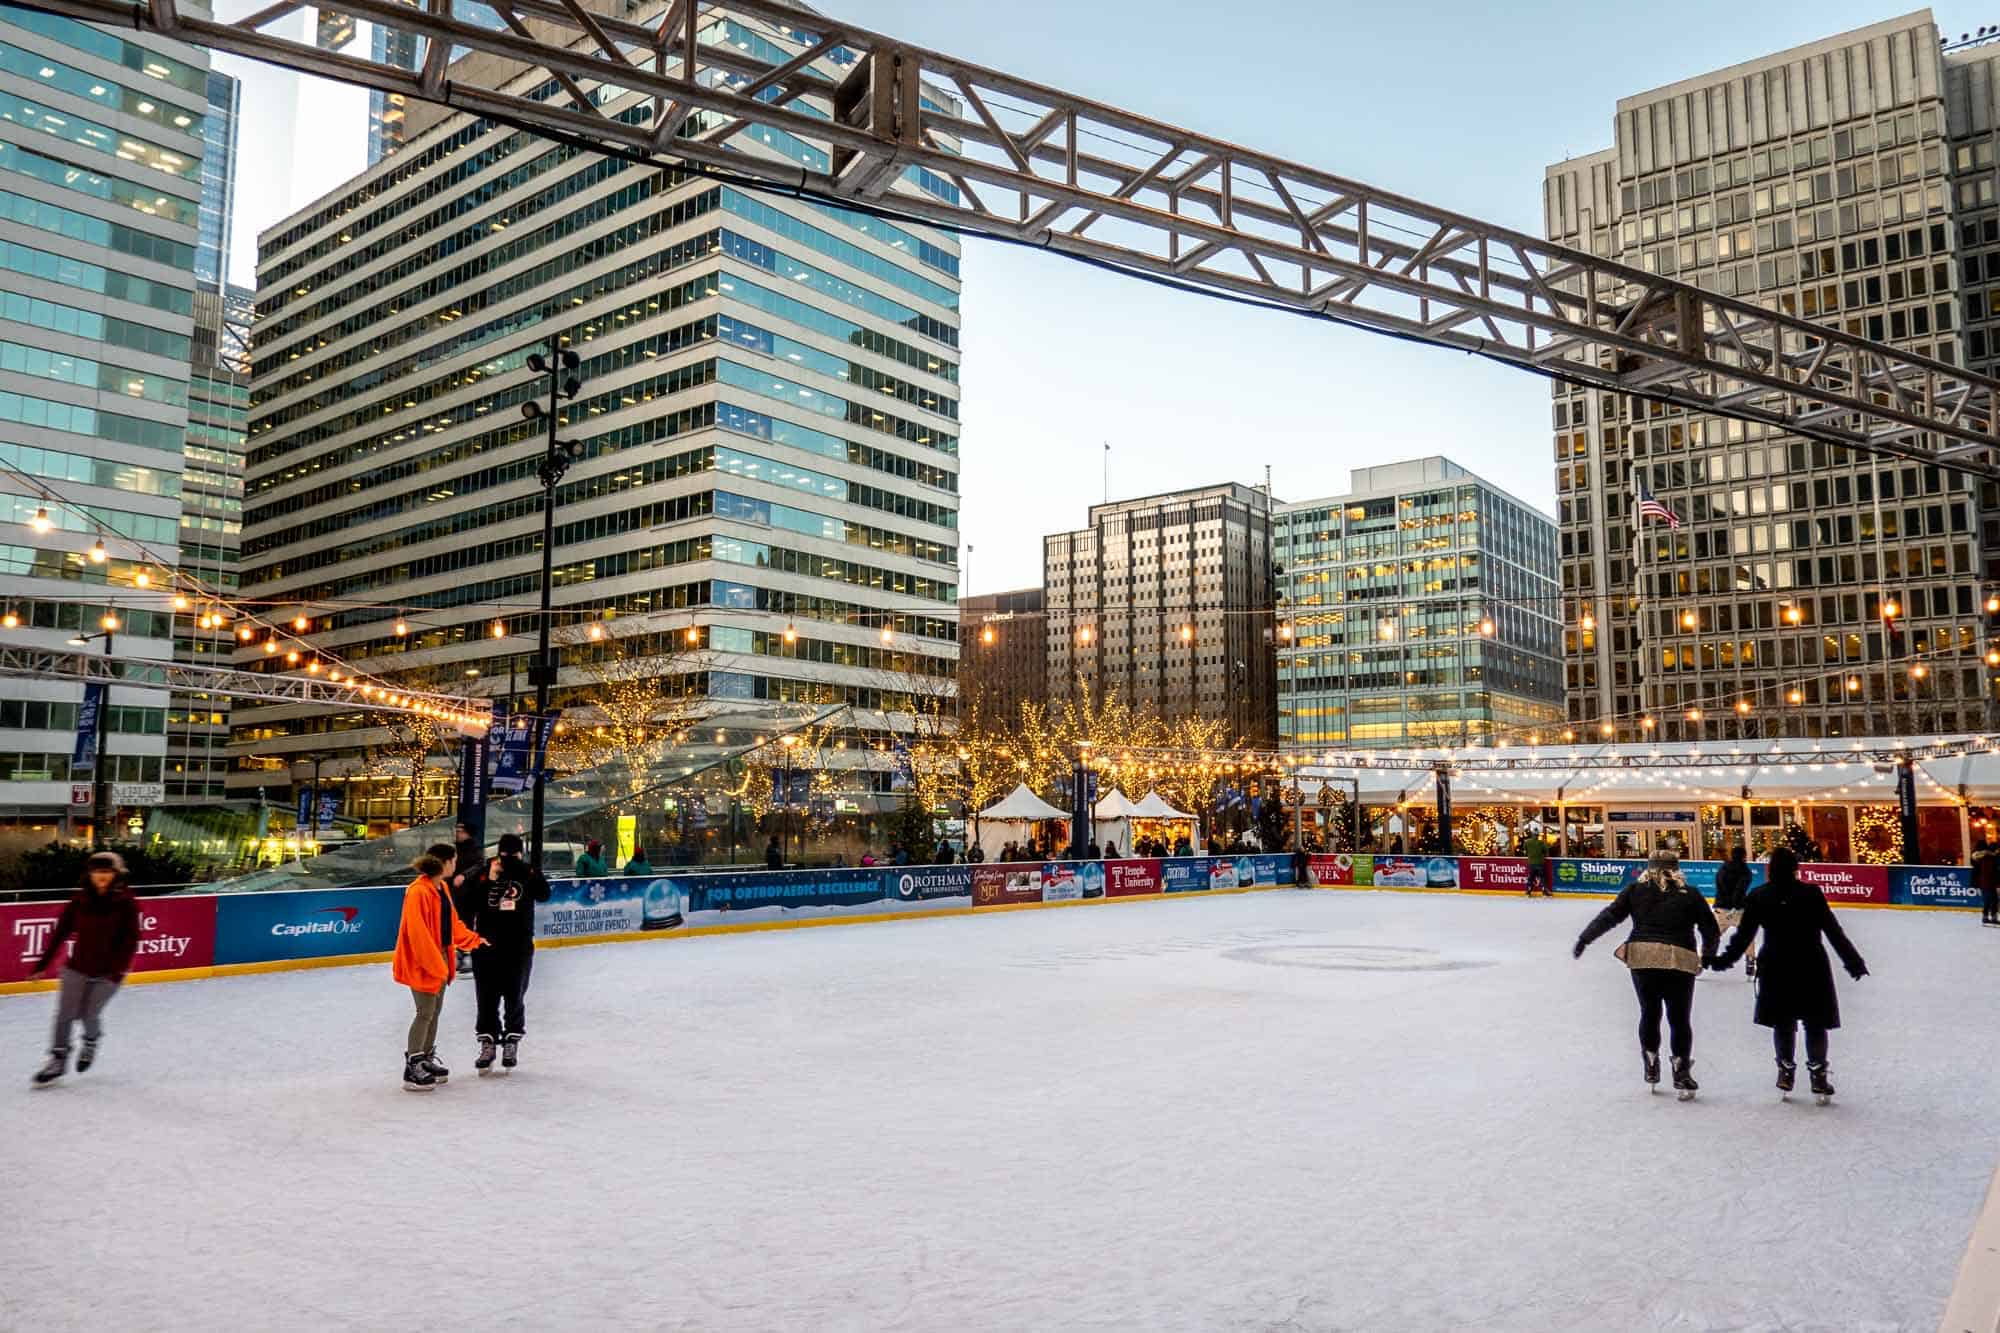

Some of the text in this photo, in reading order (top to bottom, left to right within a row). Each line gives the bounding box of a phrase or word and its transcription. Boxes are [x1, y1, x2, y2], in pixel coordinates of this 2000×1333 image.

[1124, 866, 1146, 877] Temple
[1489, 863, 1526, 874] Temple
[1581, 863, 1625, 875] Shipley
[915, 873, 972, 887] ROTHMAN
[1124, 876, 1155, 888] University
[1490, 874, 1528, 884] Univers
[1581, 874, 1624, 885] Energy
[1805, 870, 1853, 884] Temple
[707, 881, 879, 901] FOR ORTHOPAEDIC EXCELLENCE
[1911, 886, 1947, 896] LIGHT
[552, 911, 572, 922] YOUR
[574, 910, 601, 921] STATION
[544, 924, 573, 935] BIGGEST
[574, 922, 604, 933] HOLIDAY
